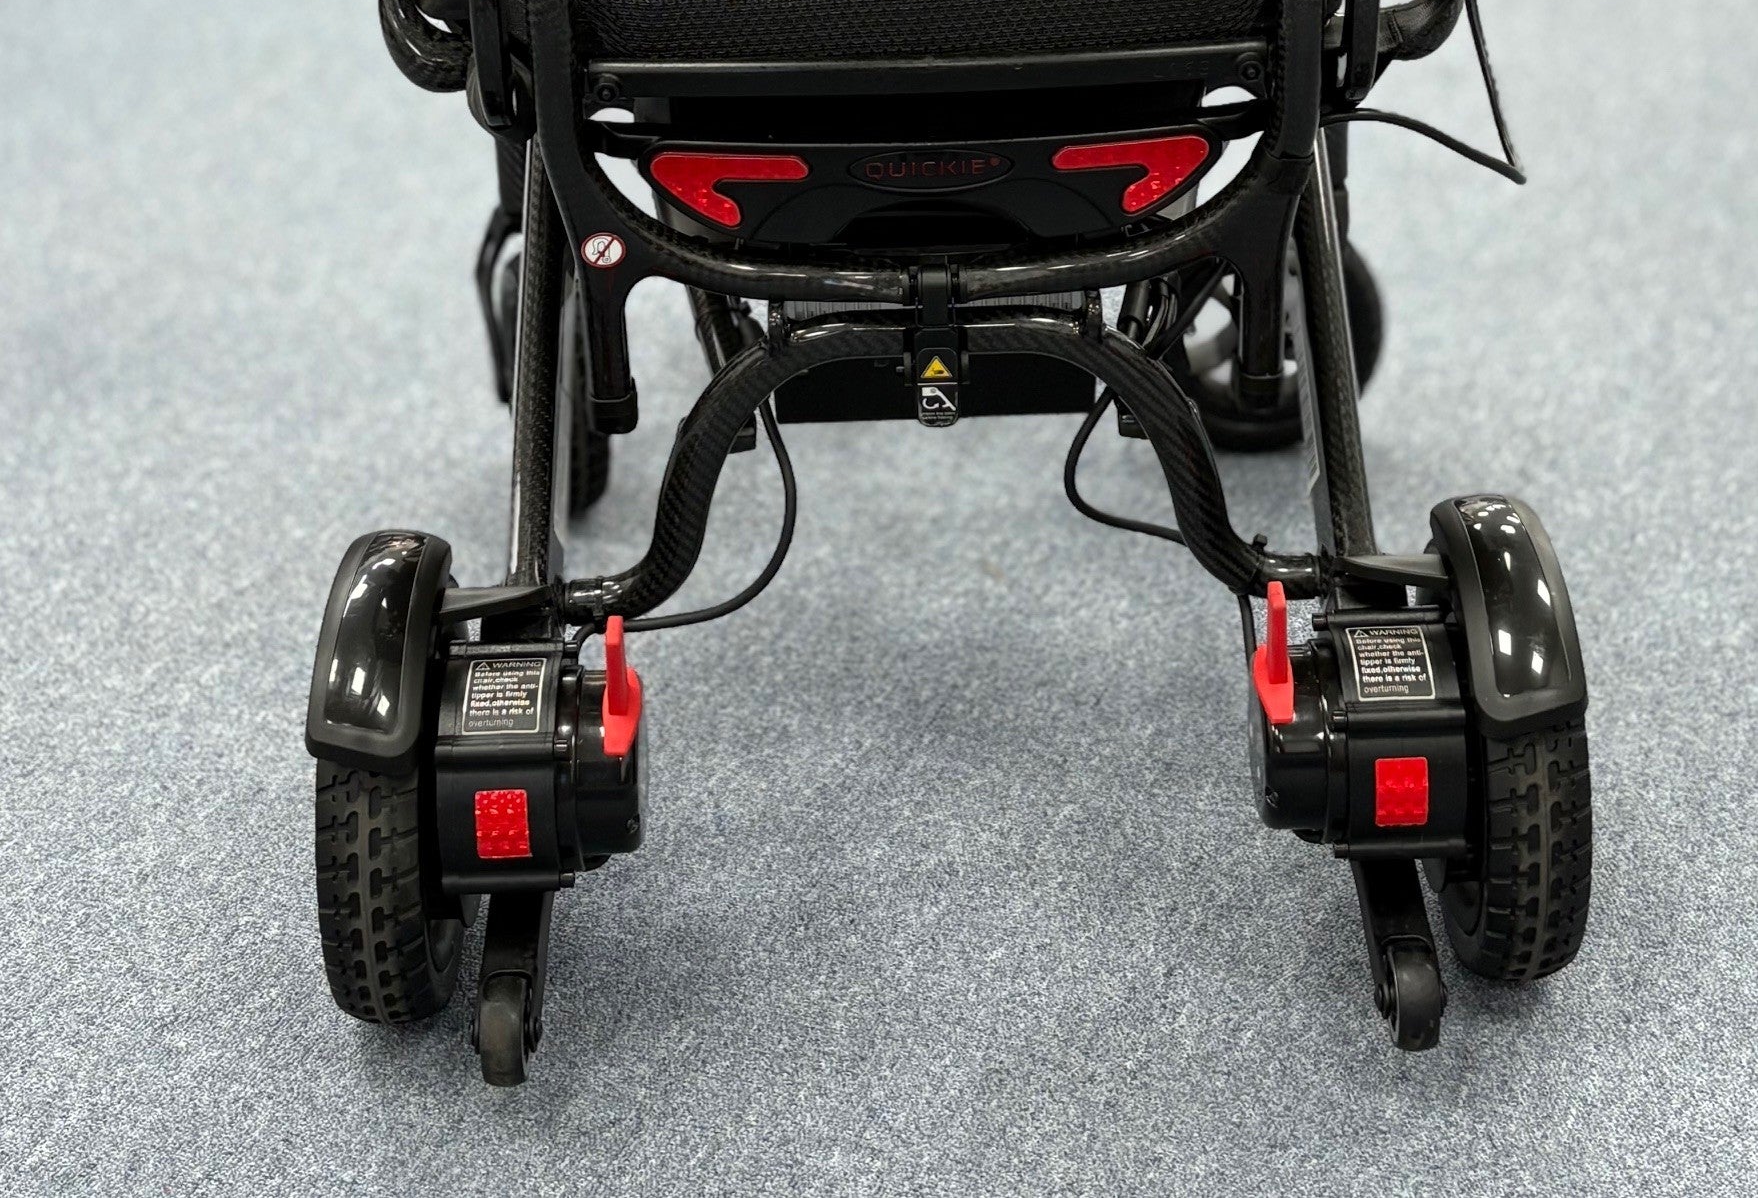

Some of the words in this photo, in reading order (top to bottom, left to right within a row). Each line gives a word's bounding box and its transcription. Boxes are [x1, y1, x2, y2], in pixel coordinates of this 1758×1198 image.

[1394, 657, 1415, 665] firmly
[1363, 675, 1383, 683] there
[1419, 673, 1427, 681] of
[1364, 685, 1409, 694] overturning
[469, 709, 490, 717] there
[526, 707, 534, 715] of
[469, 718, 513, 727] overturning
